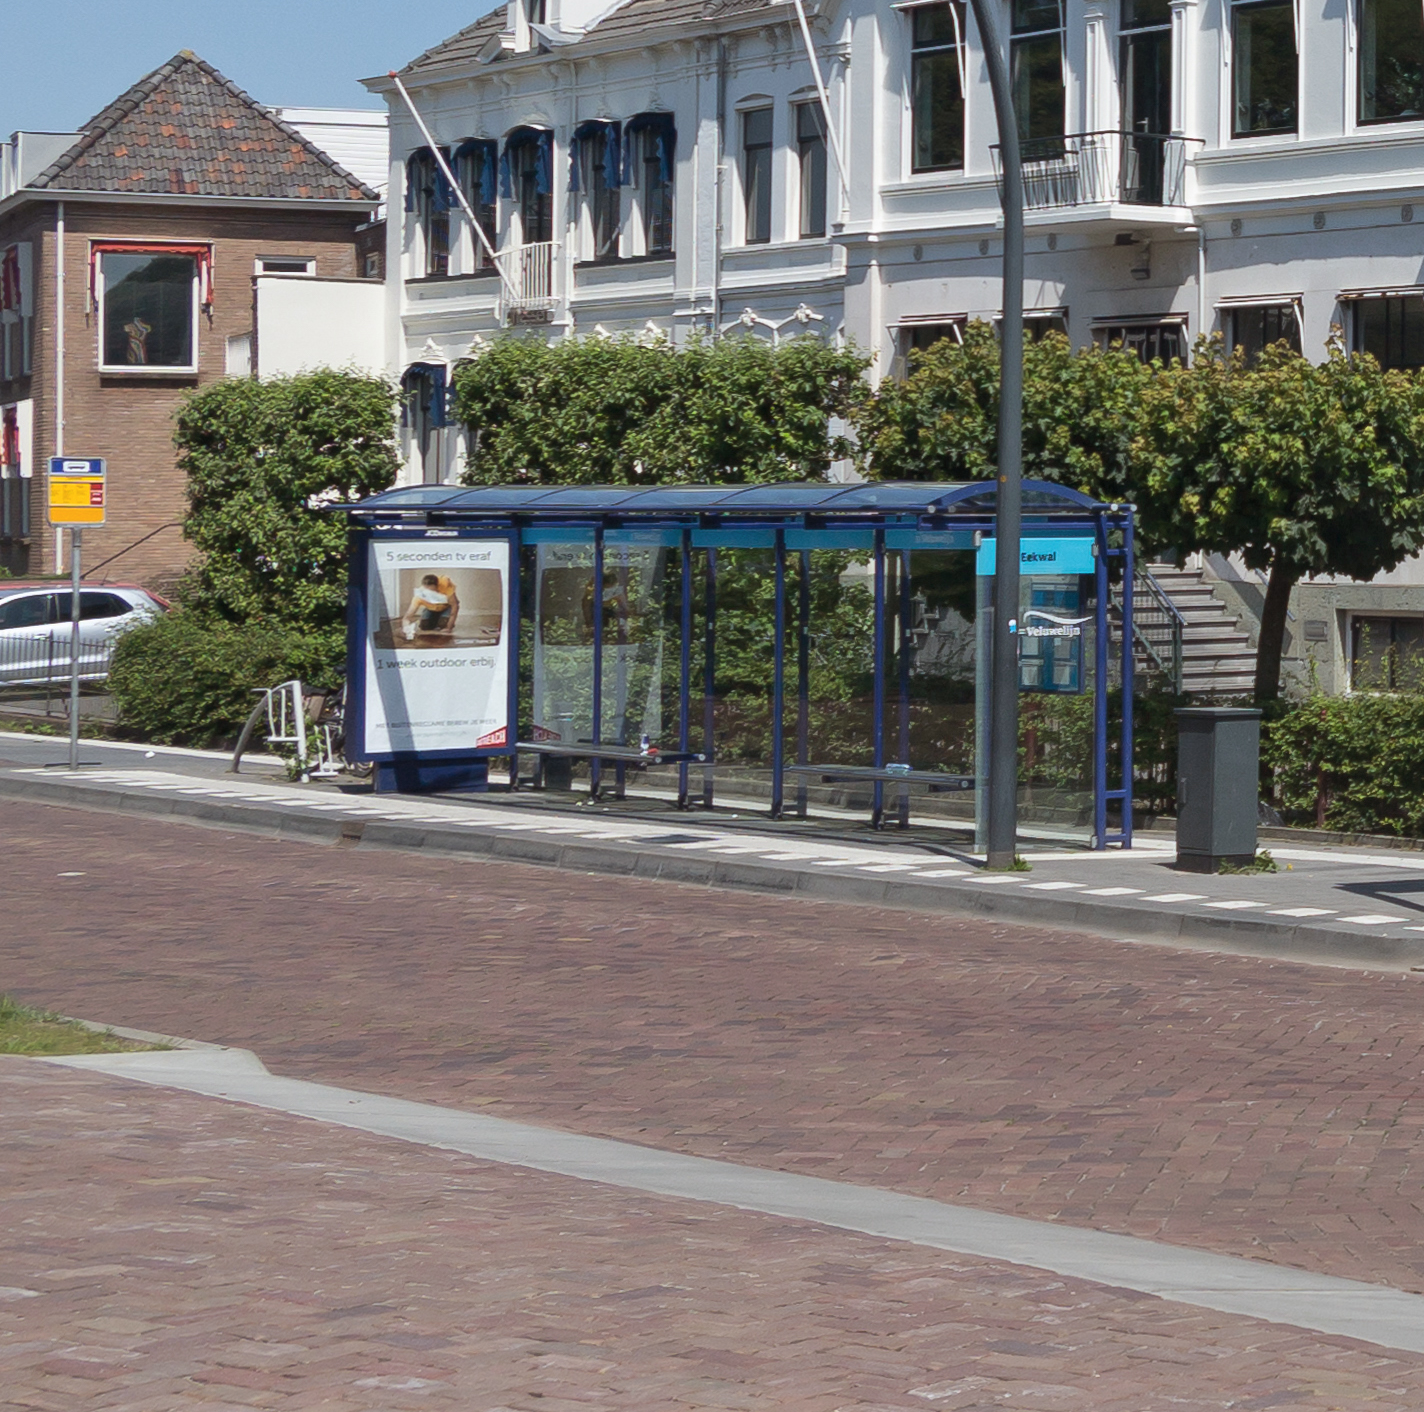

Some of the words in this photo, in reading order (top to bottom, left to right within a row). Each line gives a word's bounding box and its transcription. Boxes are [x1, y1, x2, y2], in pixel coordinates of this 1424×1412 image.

[386, 551, 394, 562] 5
[396, 551, 452, 562] seconden
[455, 552, 467, 561] tv
[469, 551, 492, 561] eraf
[1021, 551, 1057, 562] Eekwal
[376, 659, 384, 670] 1
[386, 658, 417, 669] week
[419, 657, 468, 669] outdoor
[469, 656, 497, 669] erbij.
